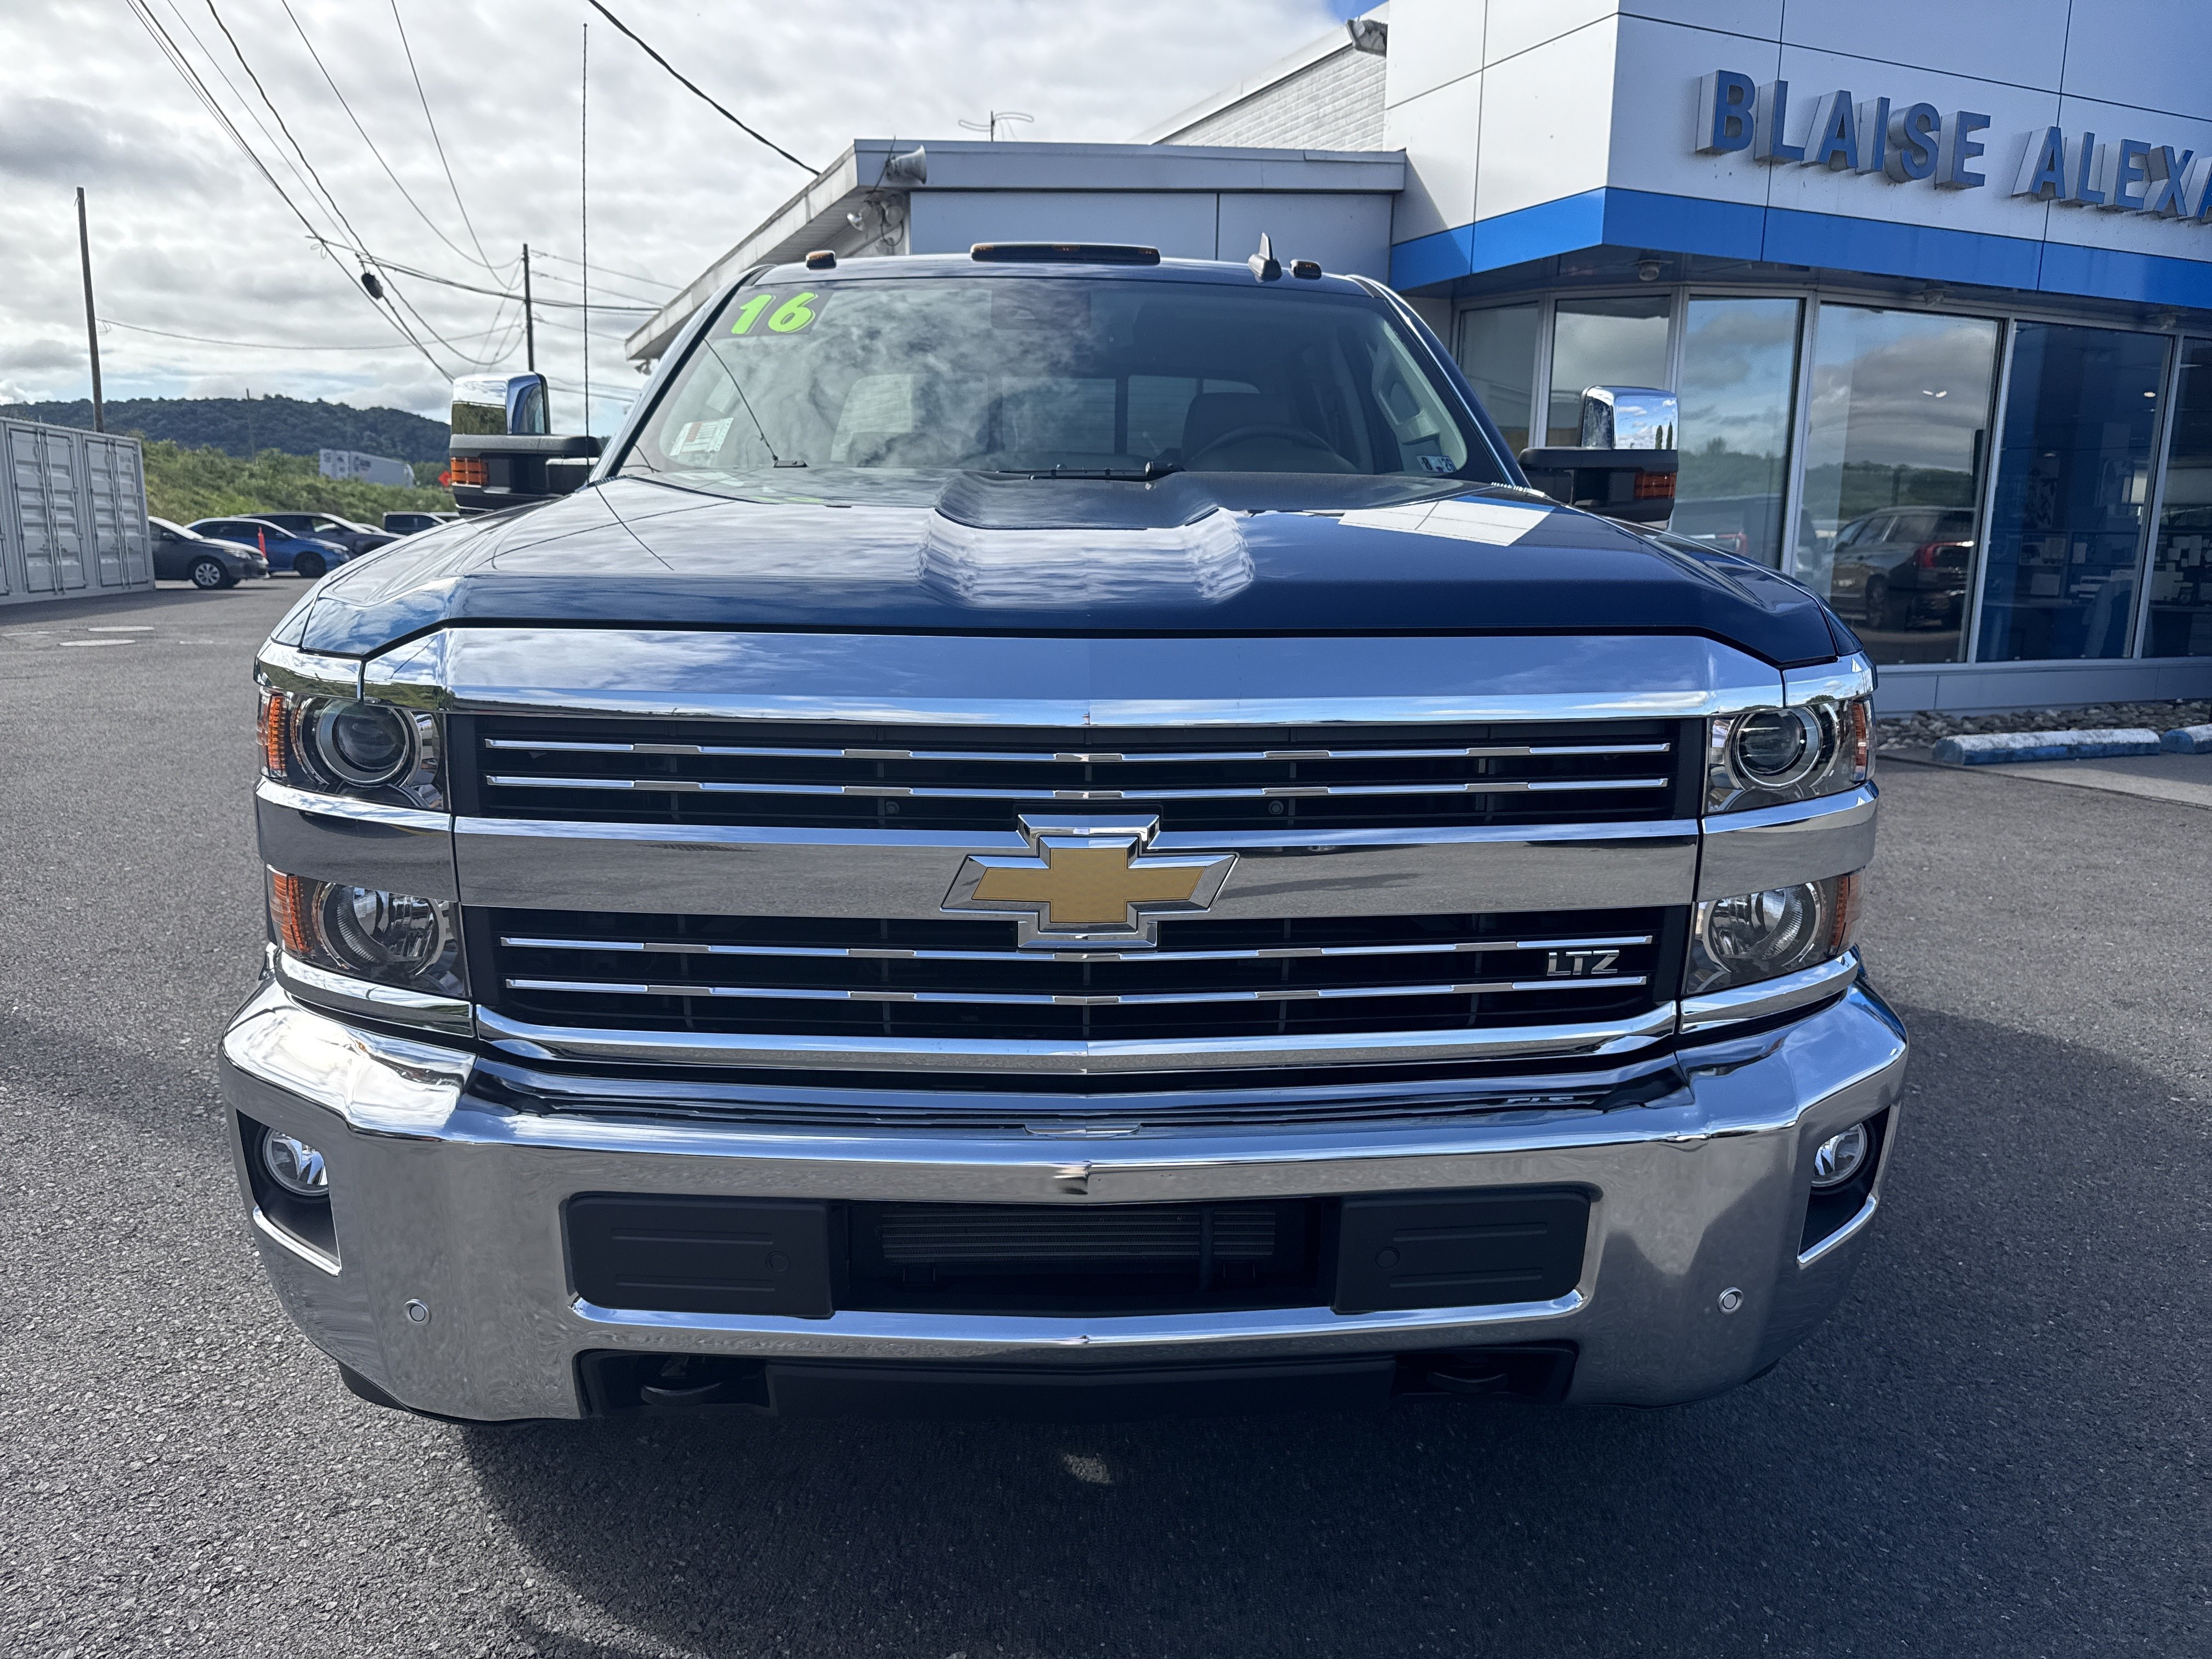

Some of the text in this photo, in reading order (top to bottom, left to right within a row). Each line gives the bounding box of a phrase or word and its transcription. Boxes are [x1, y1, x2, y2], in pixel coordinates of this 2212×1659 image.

[1711, 69, 1991, 187] BLAISE
[731, 292, 819, 335] 16
[1547, 950, 1620, 976] LTZ
